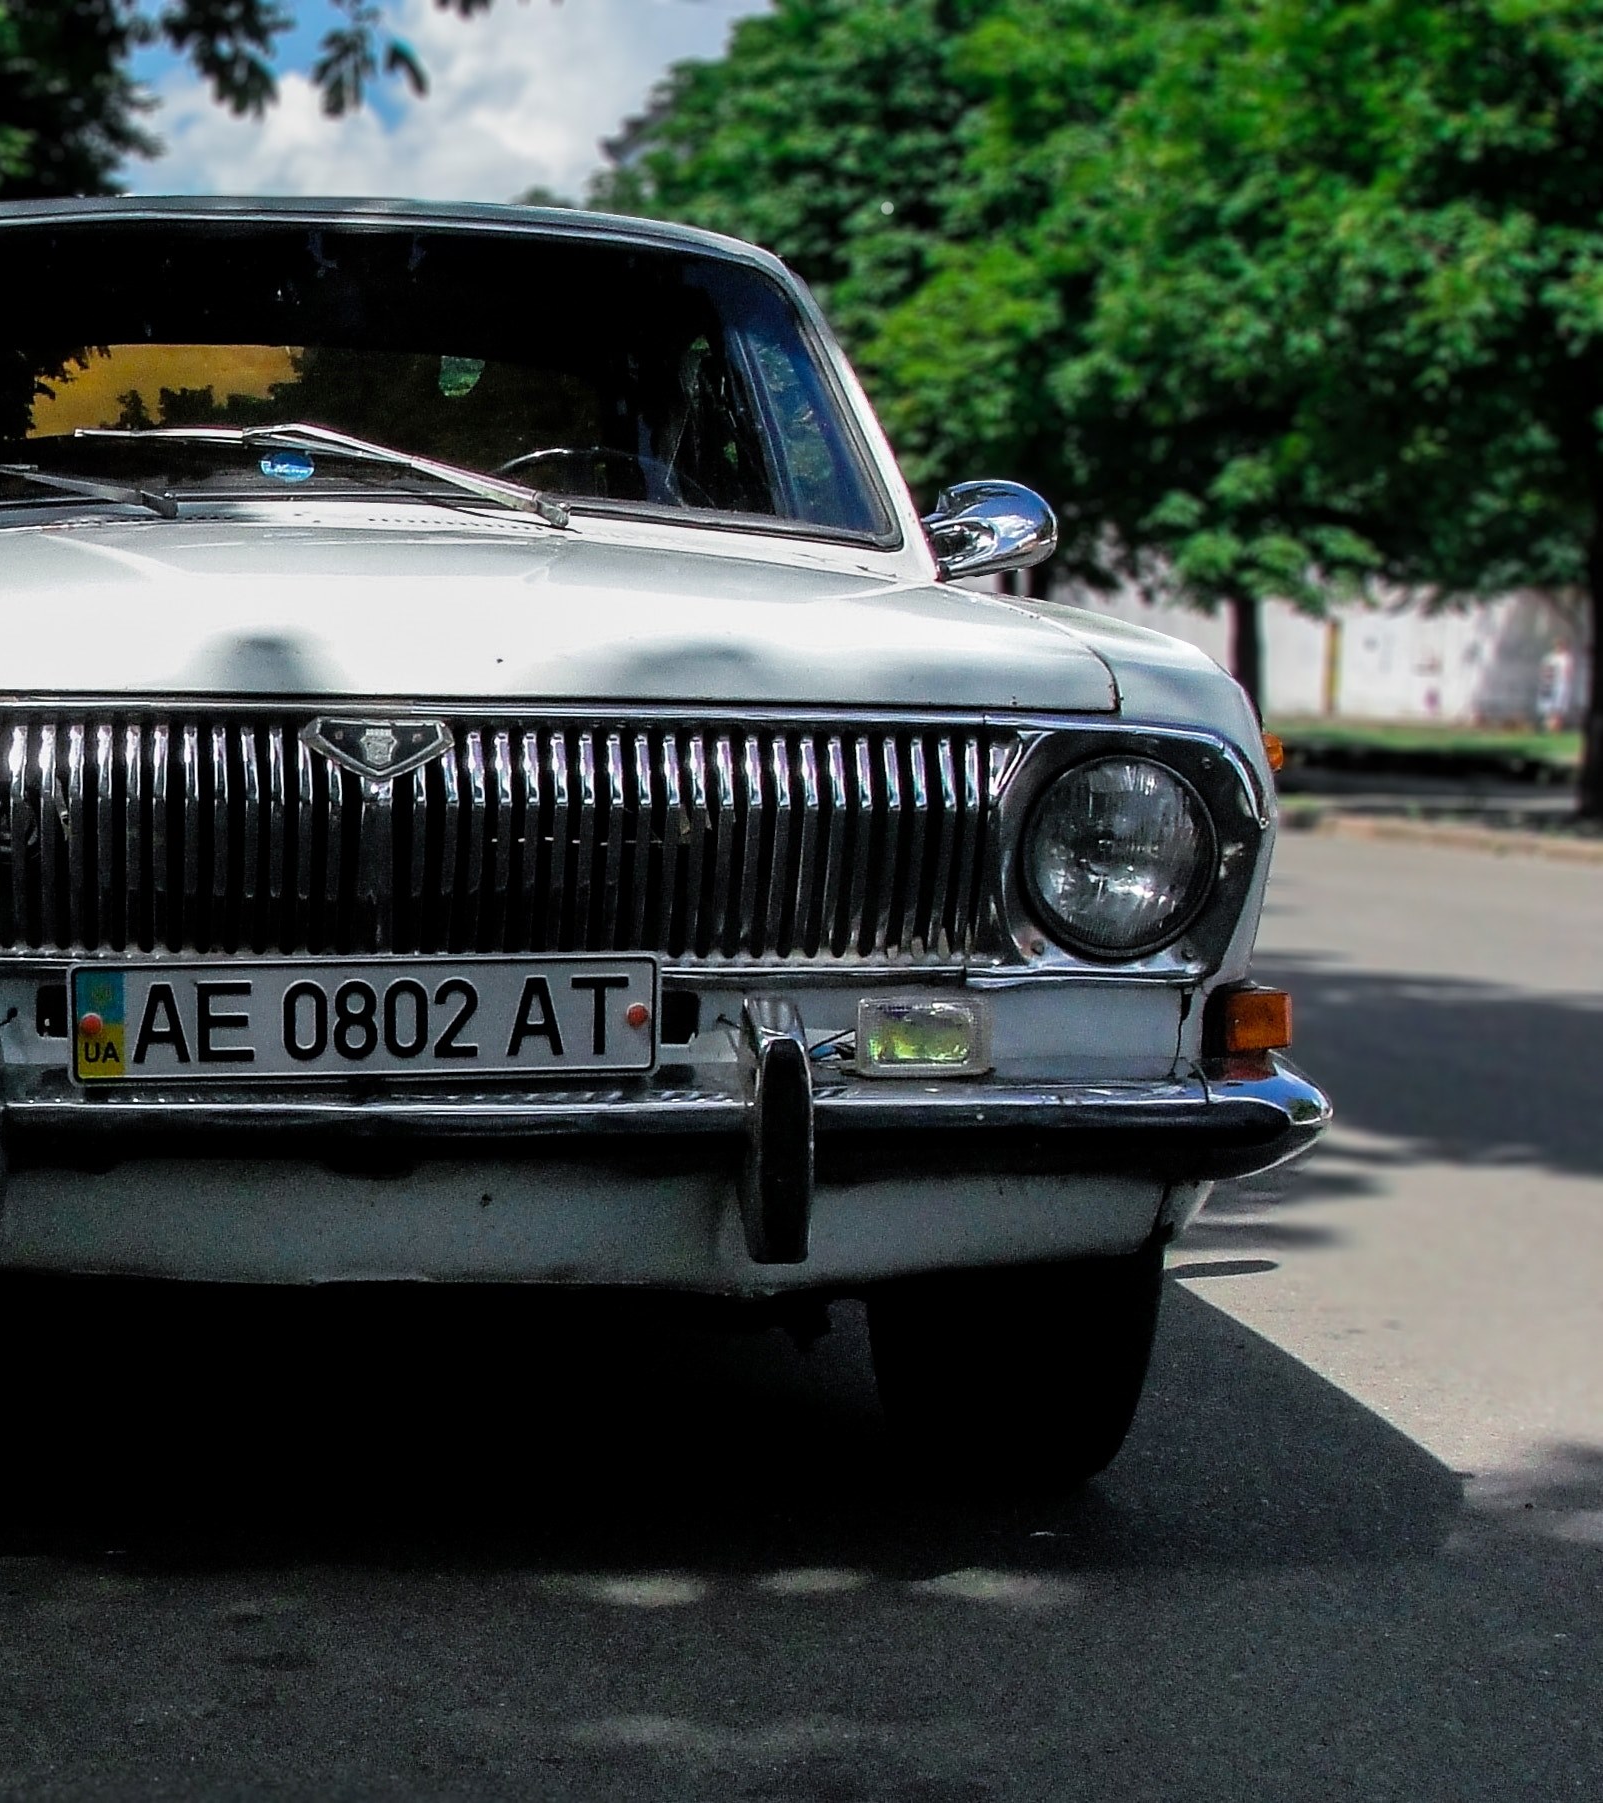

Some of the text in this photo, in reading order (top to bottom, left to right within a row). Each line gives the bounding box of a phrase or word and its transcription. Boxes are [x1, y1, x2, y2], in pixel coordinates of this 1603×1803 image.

[131, 976, 631, 1063] AE 0802 AT
[84, 1041, 121, 1064] UA
